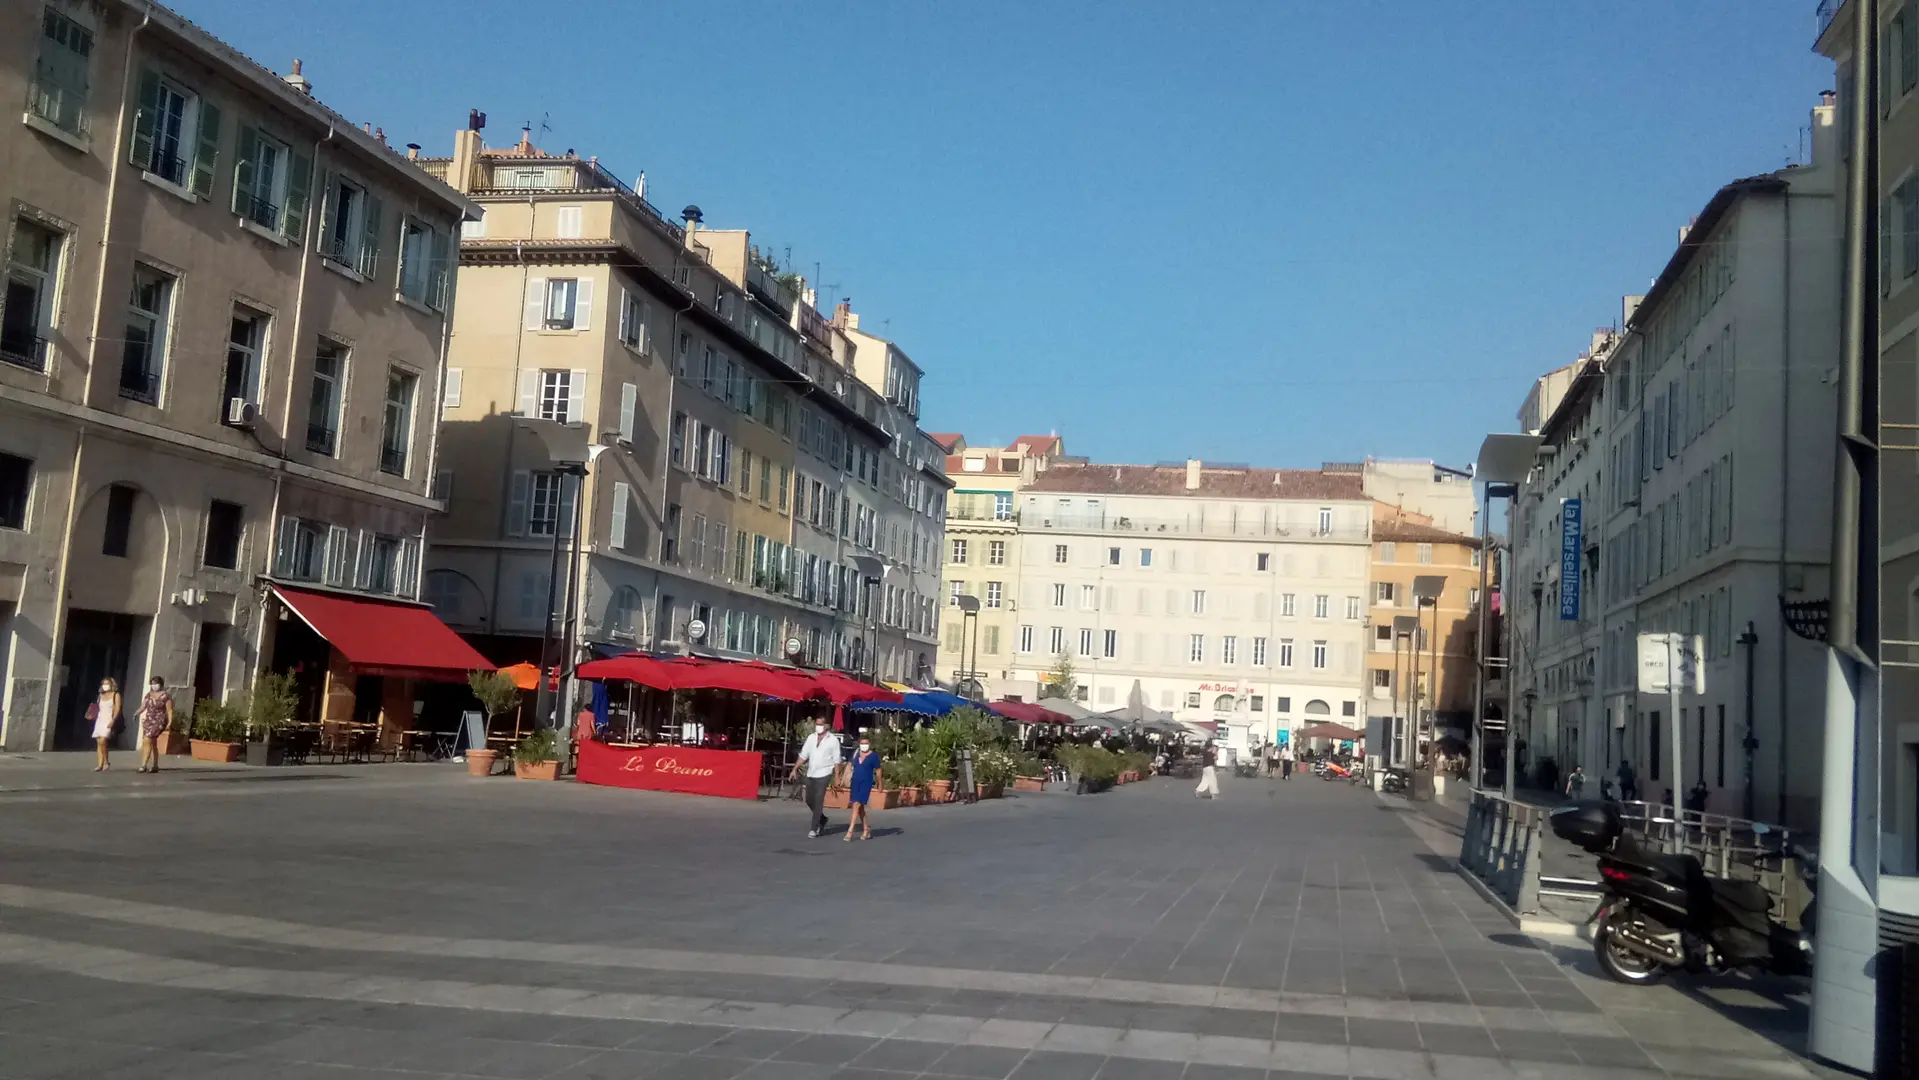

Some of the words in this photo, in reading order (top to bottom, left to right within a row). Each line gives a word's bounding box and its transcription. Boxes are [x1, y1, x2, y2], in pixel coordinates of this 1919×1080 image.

[1564, 504, 1579, 518] la
[1562, 521, 1579, 615] Marseillaise
[619, 755, 644, 771] Le
[655, 757, 713, 776] Peano
